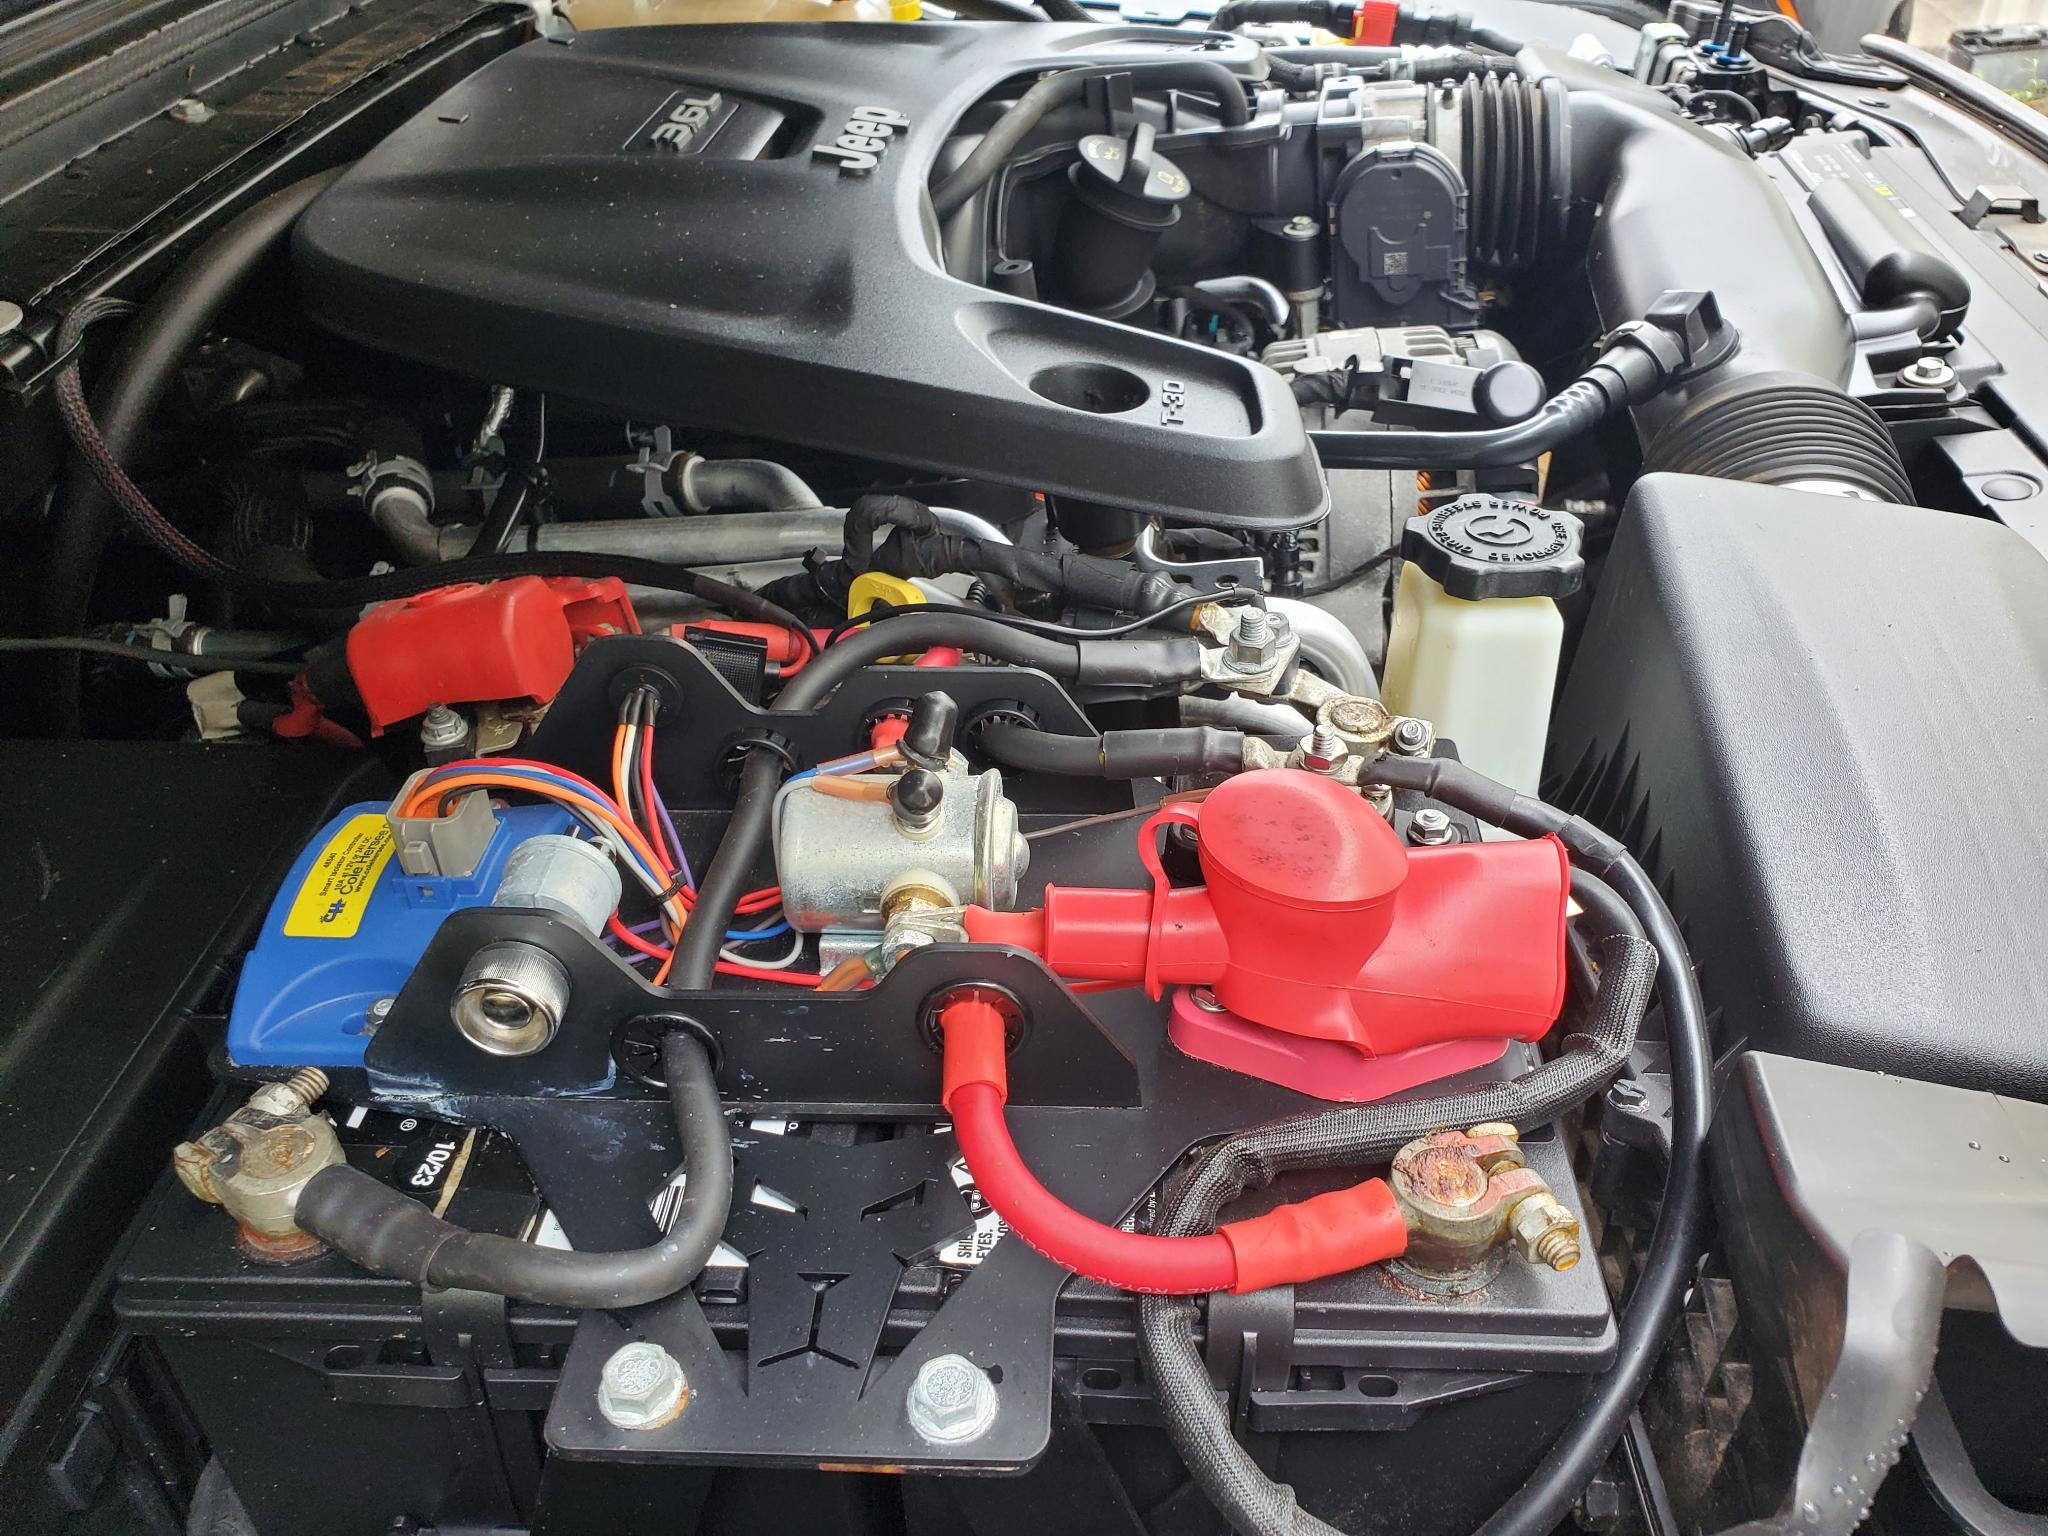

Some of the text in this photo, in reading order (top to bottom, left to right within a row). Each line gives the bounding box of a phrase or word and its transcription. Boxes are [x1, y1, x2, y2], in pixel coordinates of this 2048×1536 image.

[812, 106, 911, 170] Jeep
[1161, 380, 1185, 426] T-30
[319, 874, 333, 897] Smart
[340, 866, 364, 895] Cole
[358, 830, 389, 864] Hersee
[411, 1141, 456, 1186] 10/23
